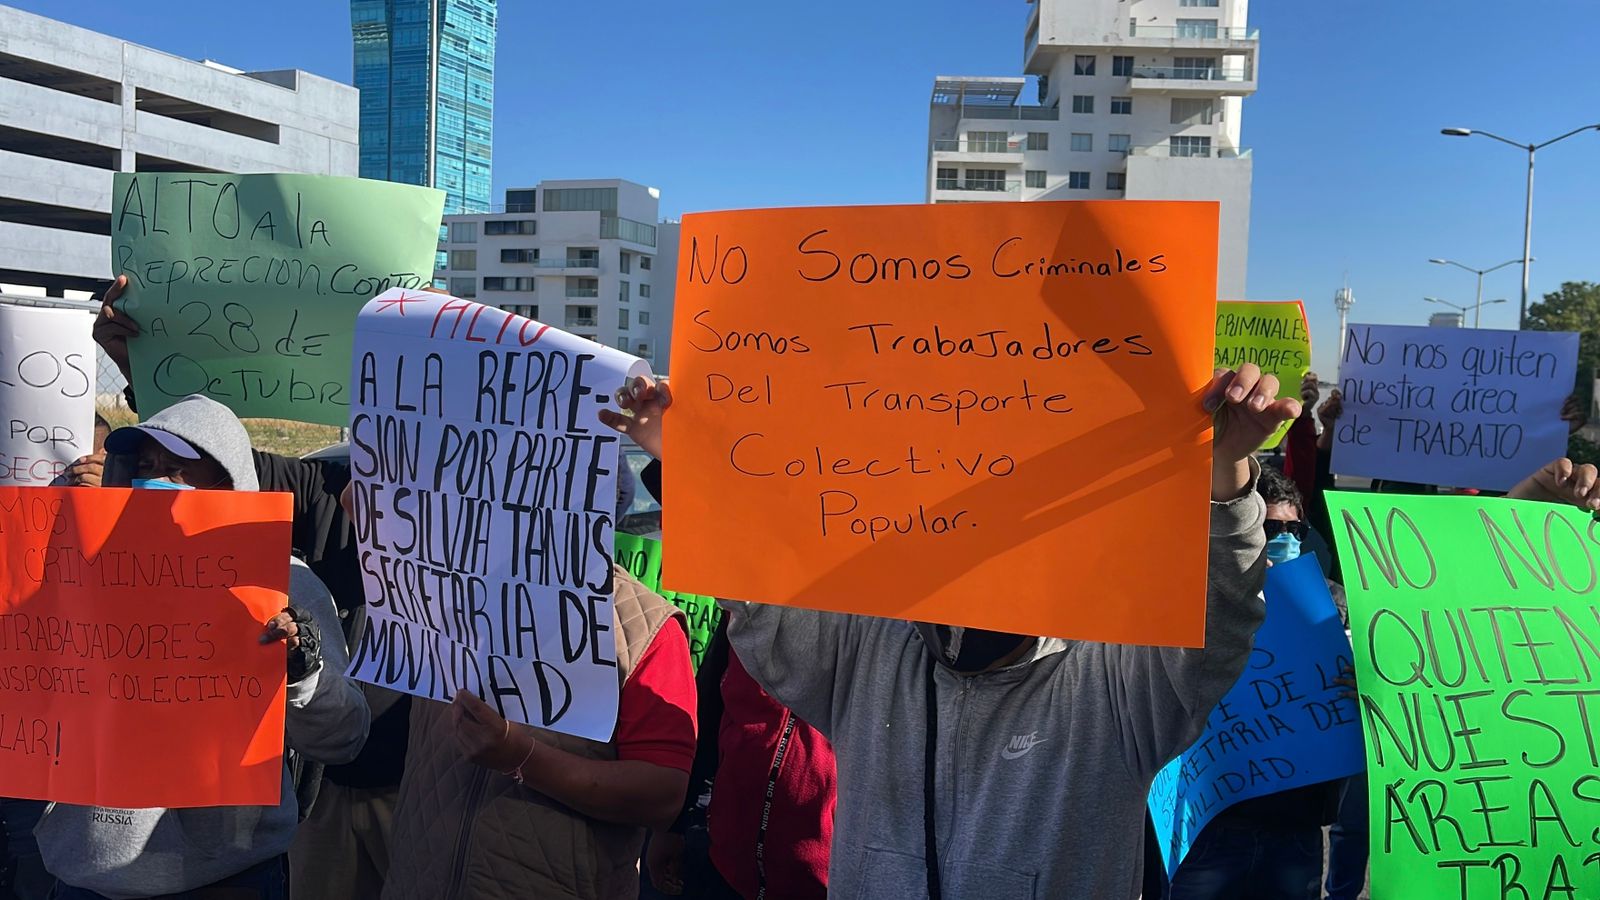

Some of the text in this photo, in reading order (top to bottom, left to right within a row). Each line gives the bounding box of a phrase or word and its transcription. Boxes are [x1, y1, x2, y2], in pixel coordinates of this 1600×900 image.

[118, 177, 240, 239] ALTO
[991, 236, 1167, 279] Criminales
[179, 301, 260, 354] 28
[1345, 327, 1557, 385] No nos quiten
[360, 349, 610, 434] A LA REPRE-
[706, 373, 1074, 426] Del Transporte
[1343, 373, 1518, 414] nuestra área
[10, 419, 79, 450] POR
[730, 432, 1015, 478] Colectivo
[1338, 414, 1523, 460] de TRABAJO
[352, 414, 617, 516] SION POR PARTE
[354, 479, 614, 595] DE SILVIA TANUS
[819, 490, 977, 542] Popular.
[24, 546, 239, 589] CRIMINALES
[1342, 506, 1437, 591] NO
[360, 553, 617, 667] SECRETARIA DE
[0, 612, 215, 660] TRABAJADORES
[108, 671, 262, 704] COLECTIVO
[350, 616, 572, 727] MOVILIDAD
[1249, 671, 1306, 710] DE
[773, 737, 788, 768] ROBIN
[1161, 699, 1357, 828] SECRETARIA DE
[92, 812, 133, 826] RUSSIA
[760, 780, 775, 831] NIC ROBIN
